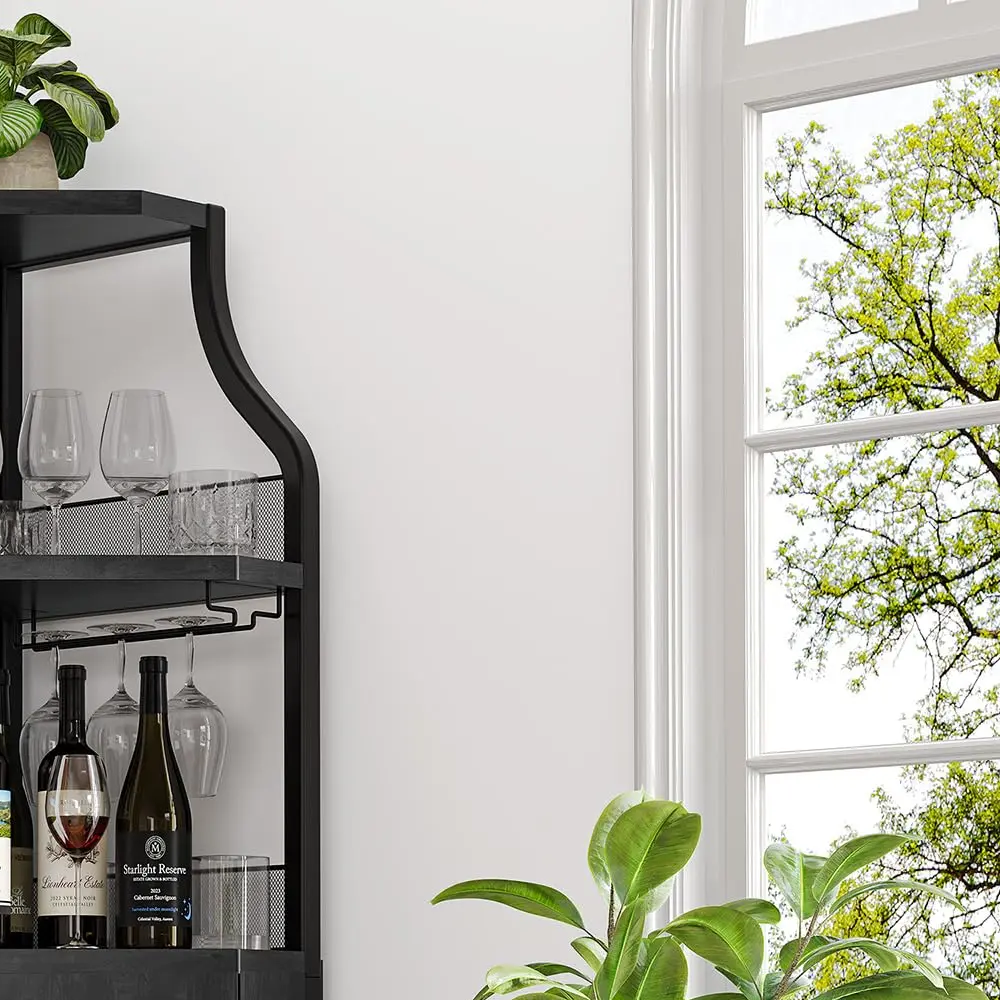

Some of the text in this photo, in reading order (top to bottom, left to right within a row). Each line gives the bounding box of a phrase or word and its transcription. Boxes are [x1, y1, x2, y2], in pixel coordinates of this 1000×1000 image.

[123, 863, 187, 877] Starlight Reserve
[154, 894, 178, 902] Sauvignon
